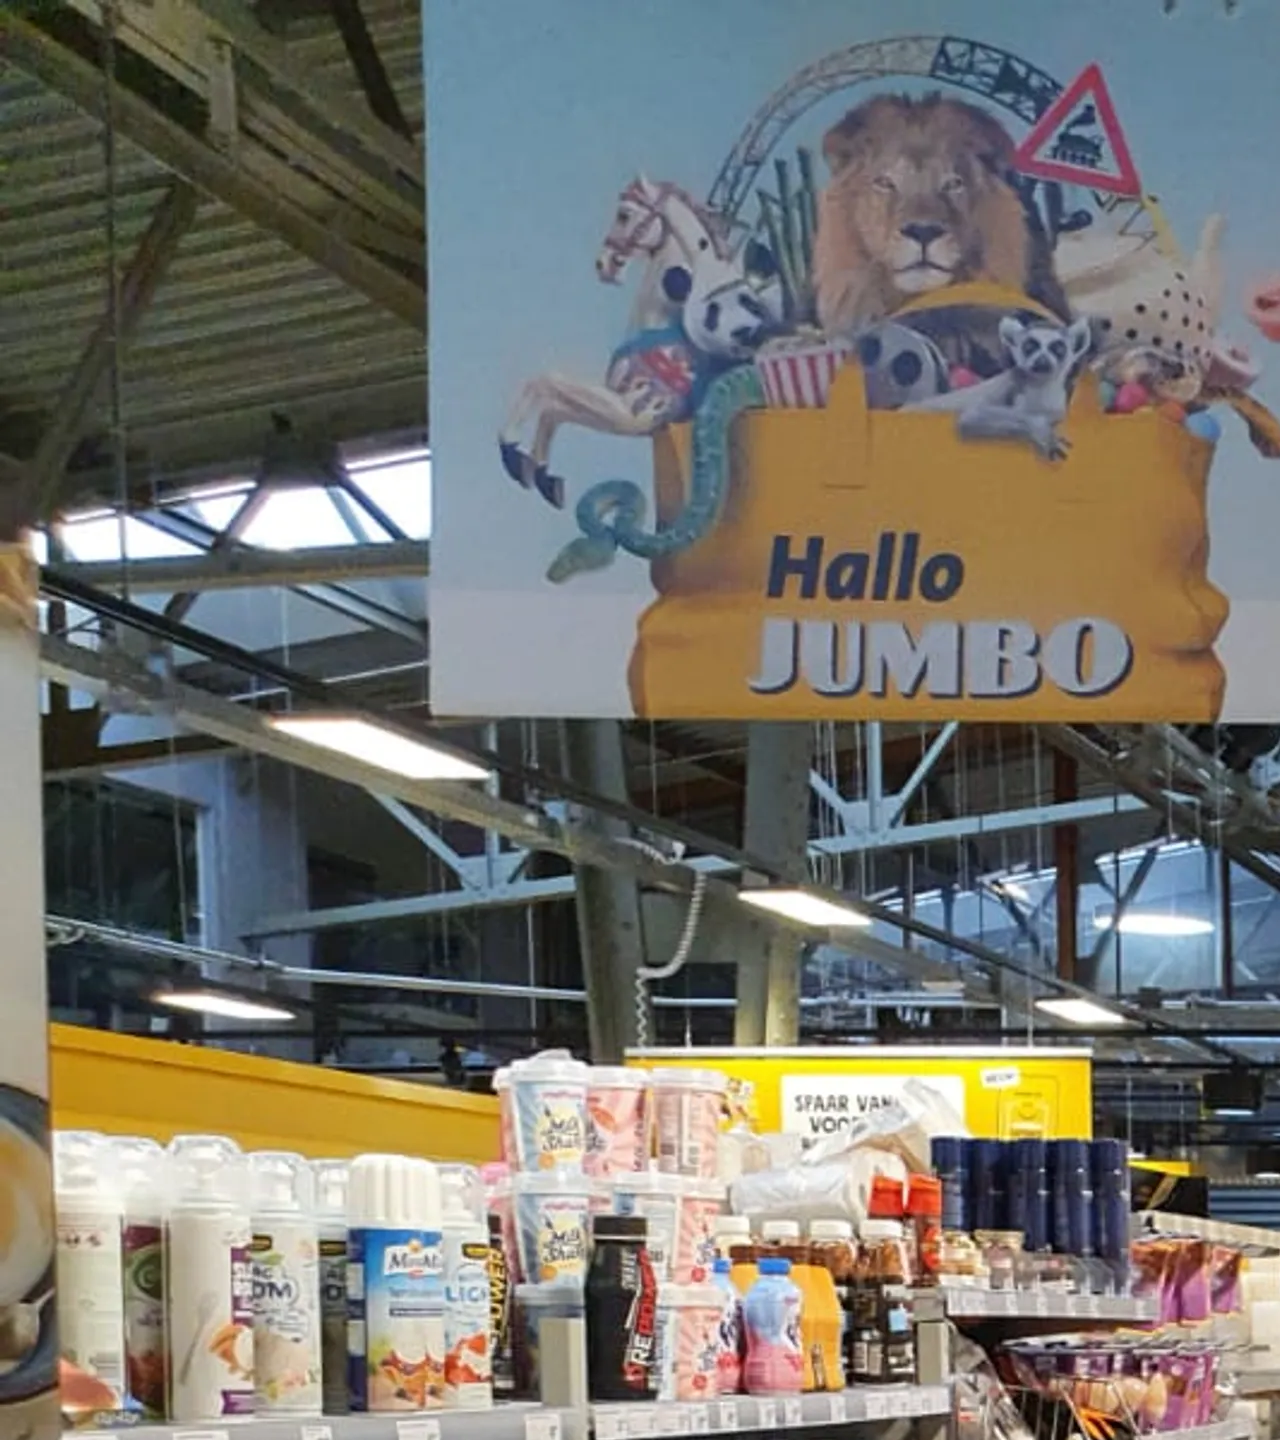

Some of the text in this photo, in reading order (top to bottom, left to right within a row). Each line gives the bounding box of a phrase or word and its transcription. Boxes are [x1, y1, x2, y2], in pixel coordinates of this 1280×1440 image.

[767, 532, 964, 602] Hallo
[746, 617, 1133, 700] JUMBO
[795, 1094, 849, 1112] SPAAR
